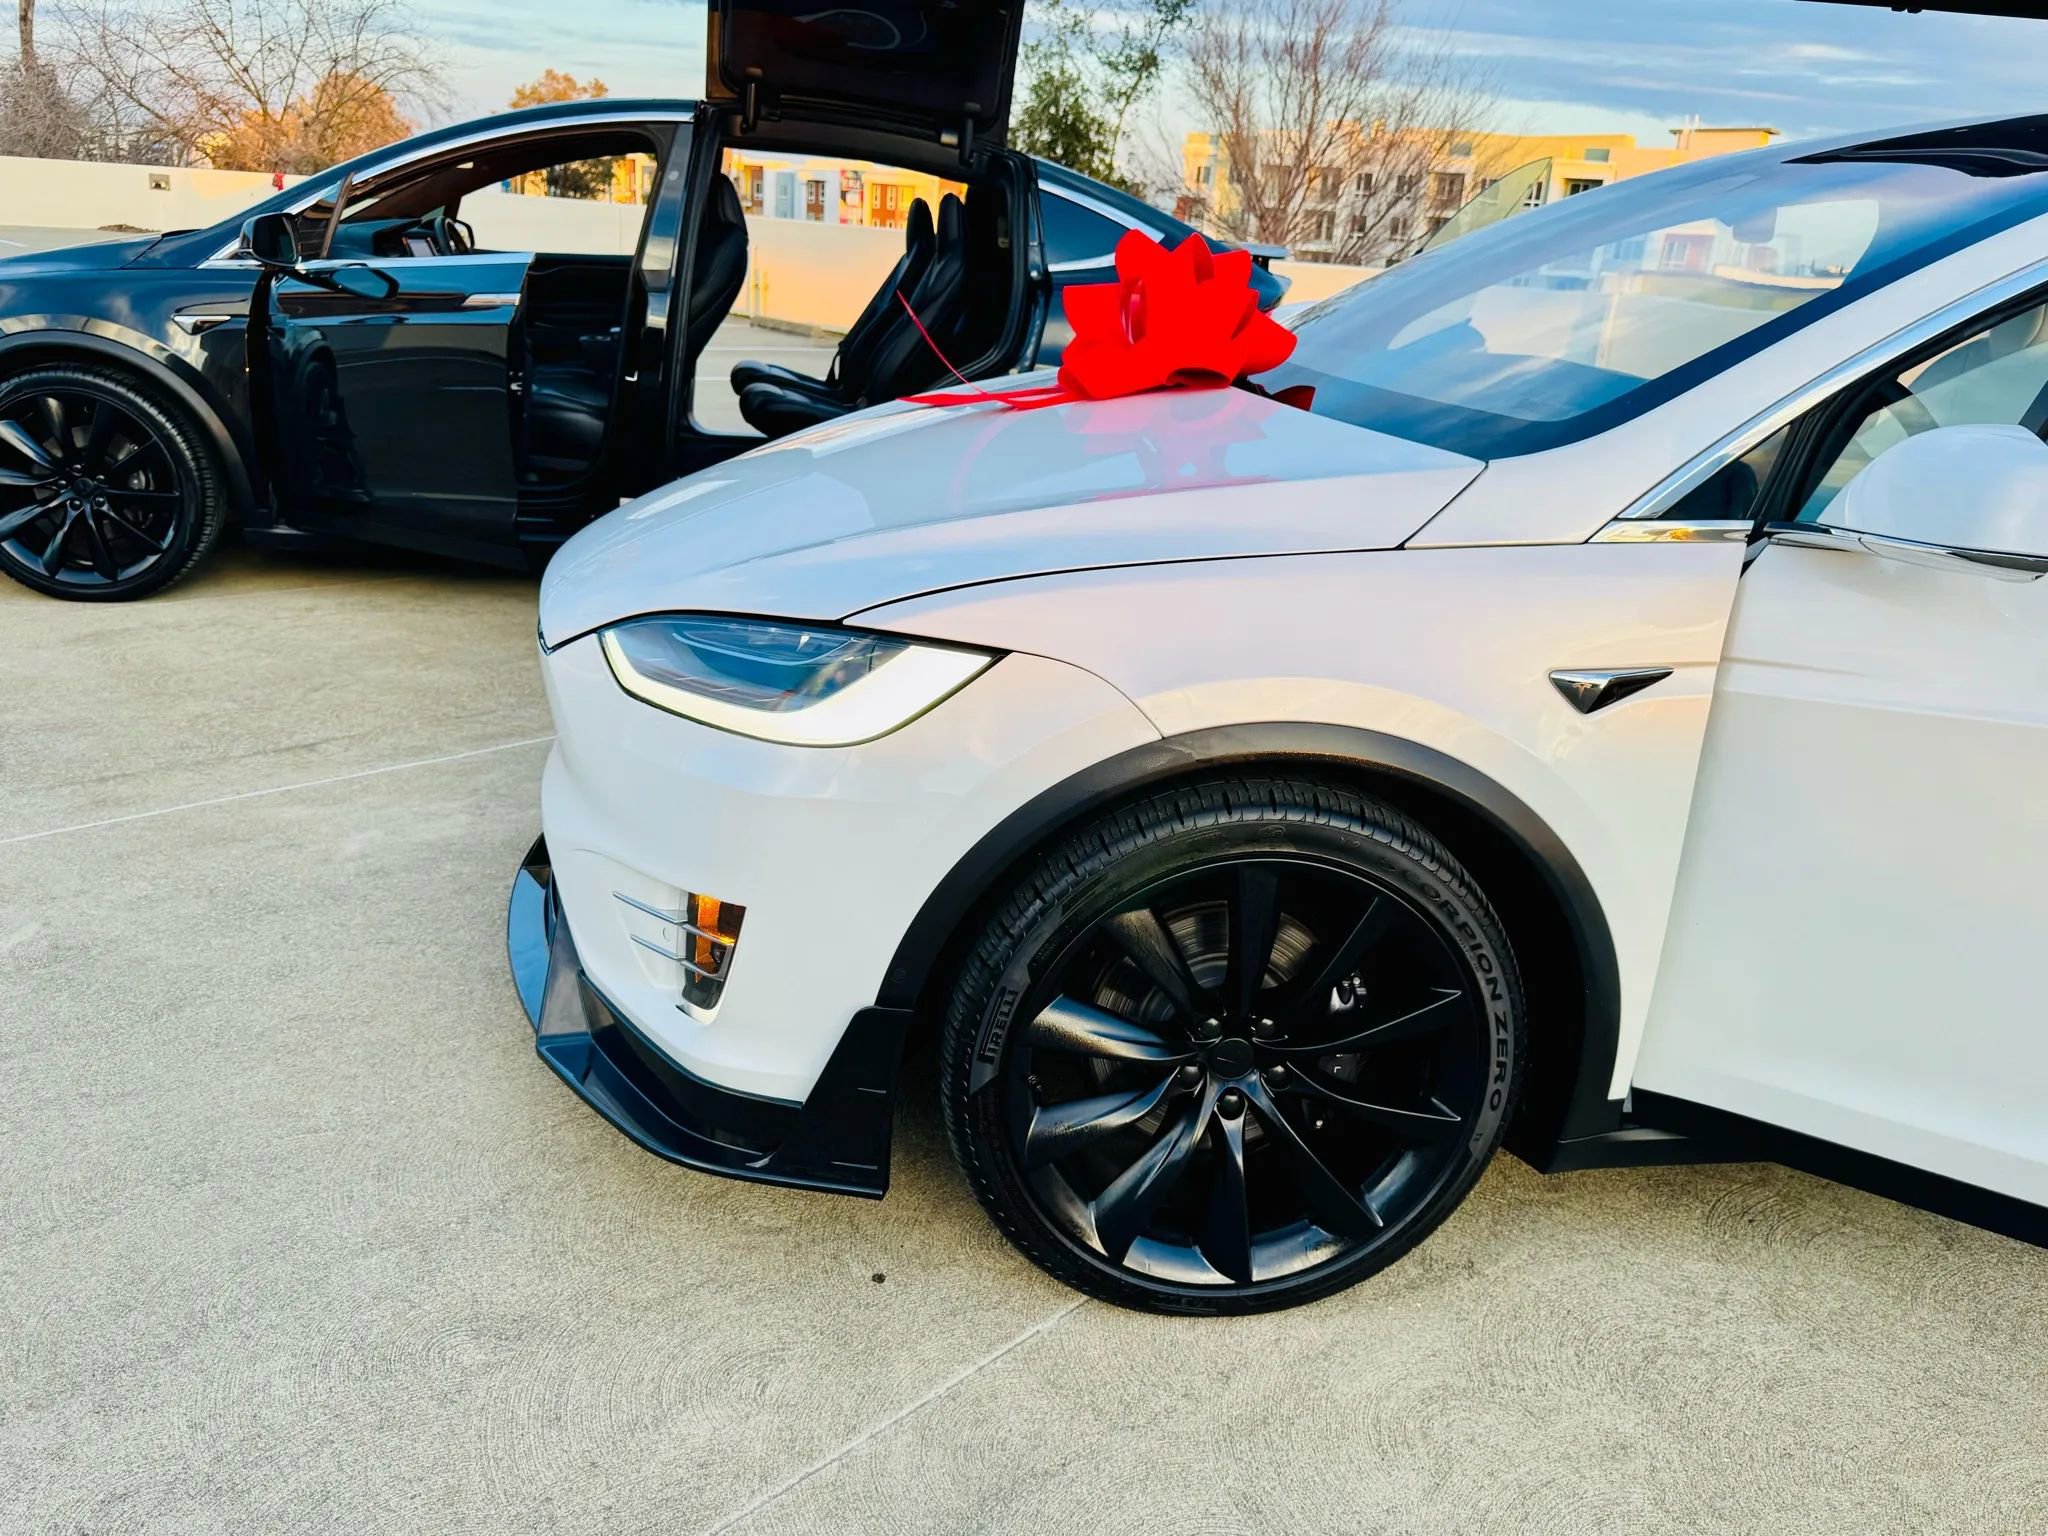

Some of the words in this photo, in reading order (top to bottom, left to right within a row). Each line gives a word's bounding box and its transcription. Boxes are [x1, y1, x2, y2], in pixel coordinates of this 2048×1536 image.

[976, 985, 1019, 1066] PIRELLI
[1376, 857, 1503, 1000] SCORPION
[1490, 1011, 1509, 1111] ZERO
